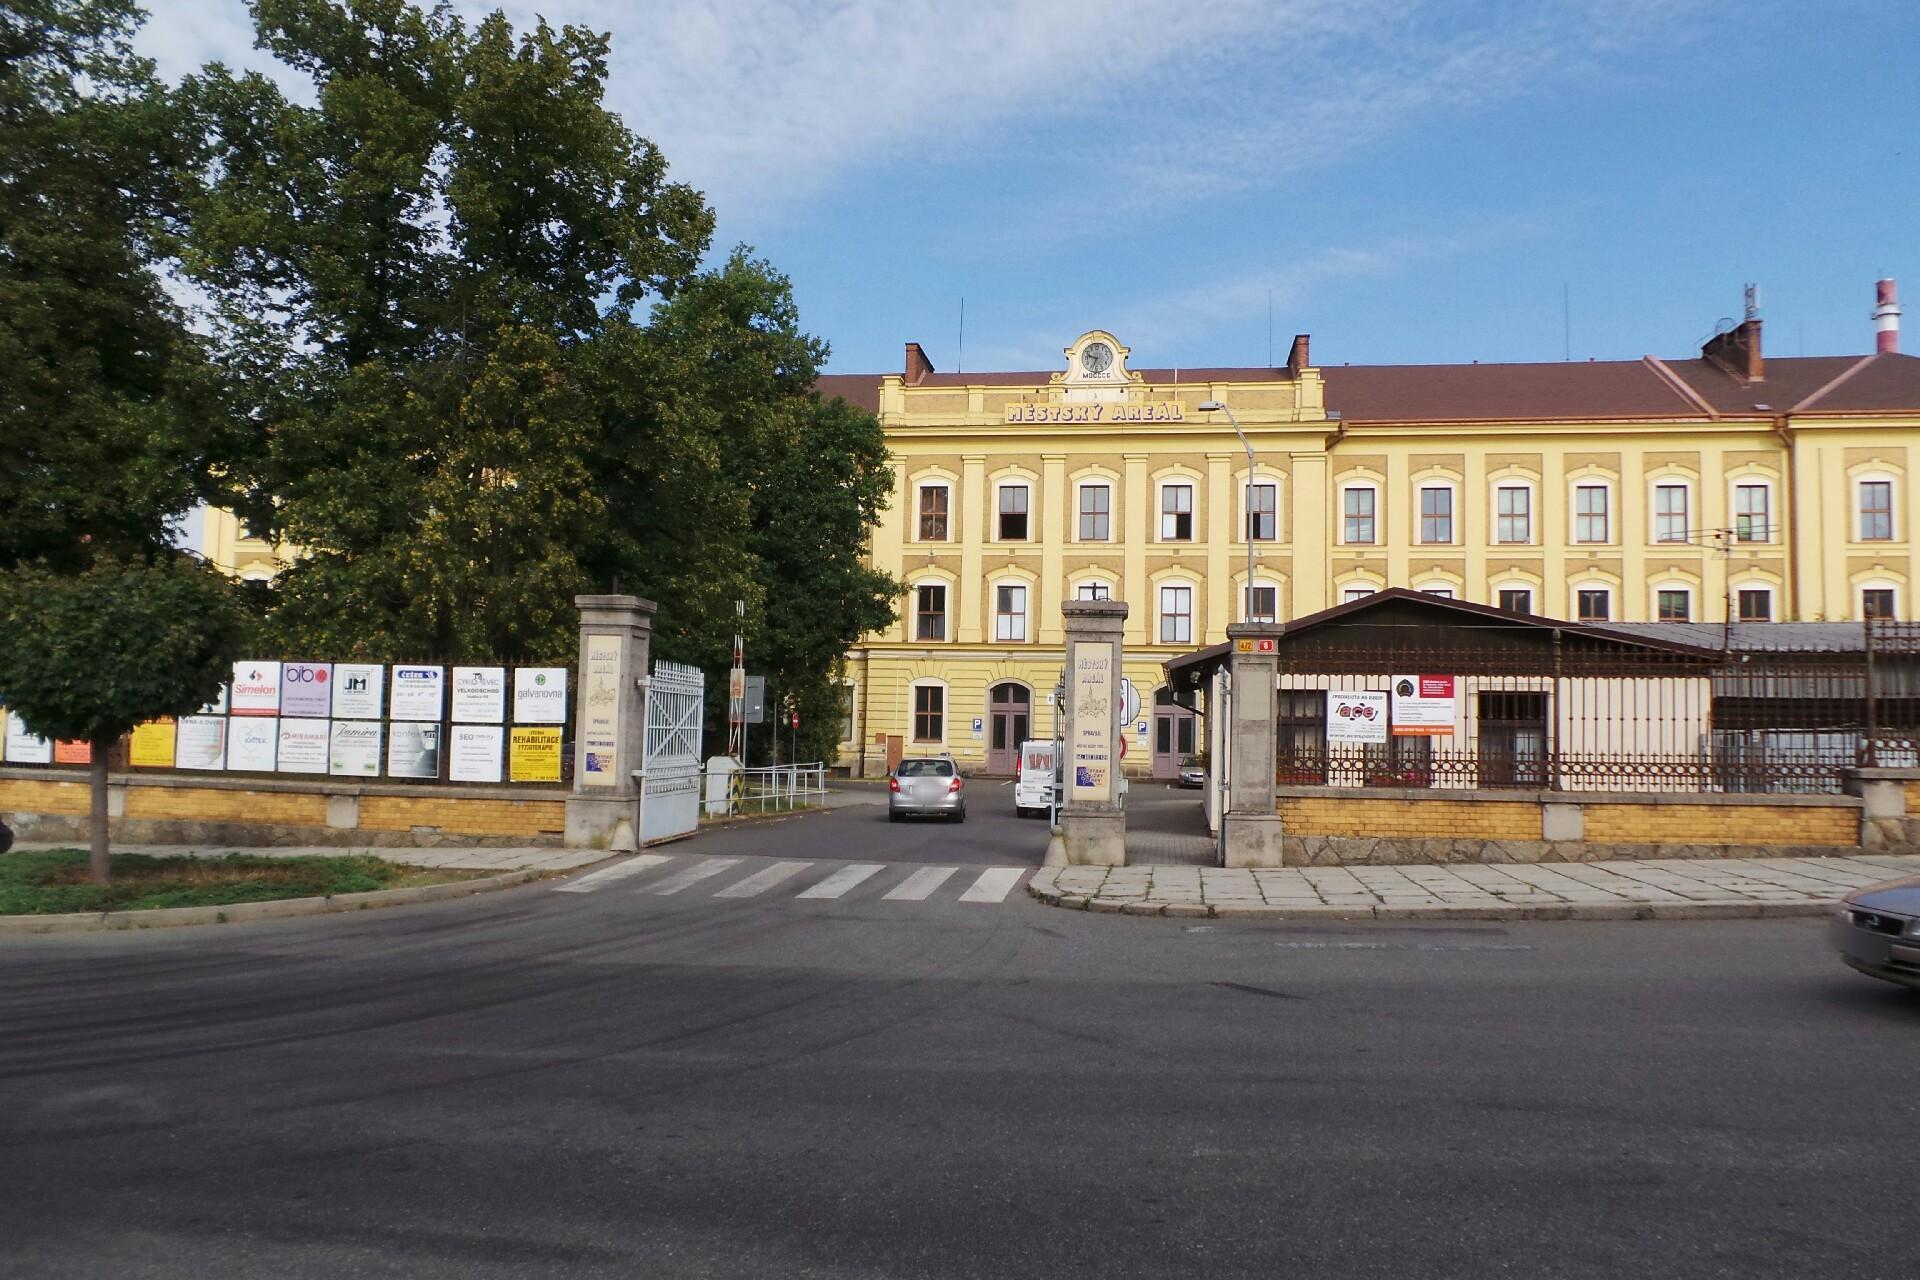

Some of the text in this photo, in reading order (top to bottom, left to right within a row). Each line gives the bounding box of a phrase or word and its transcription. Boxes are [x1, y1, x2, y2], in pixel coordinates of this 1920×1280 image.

[1008, 402, 1183, 422] MĚSTSKÝ AREÁL
[235, 684, 276, 695] Simelon
[513, 736, 560, 744] REHABILITACE
